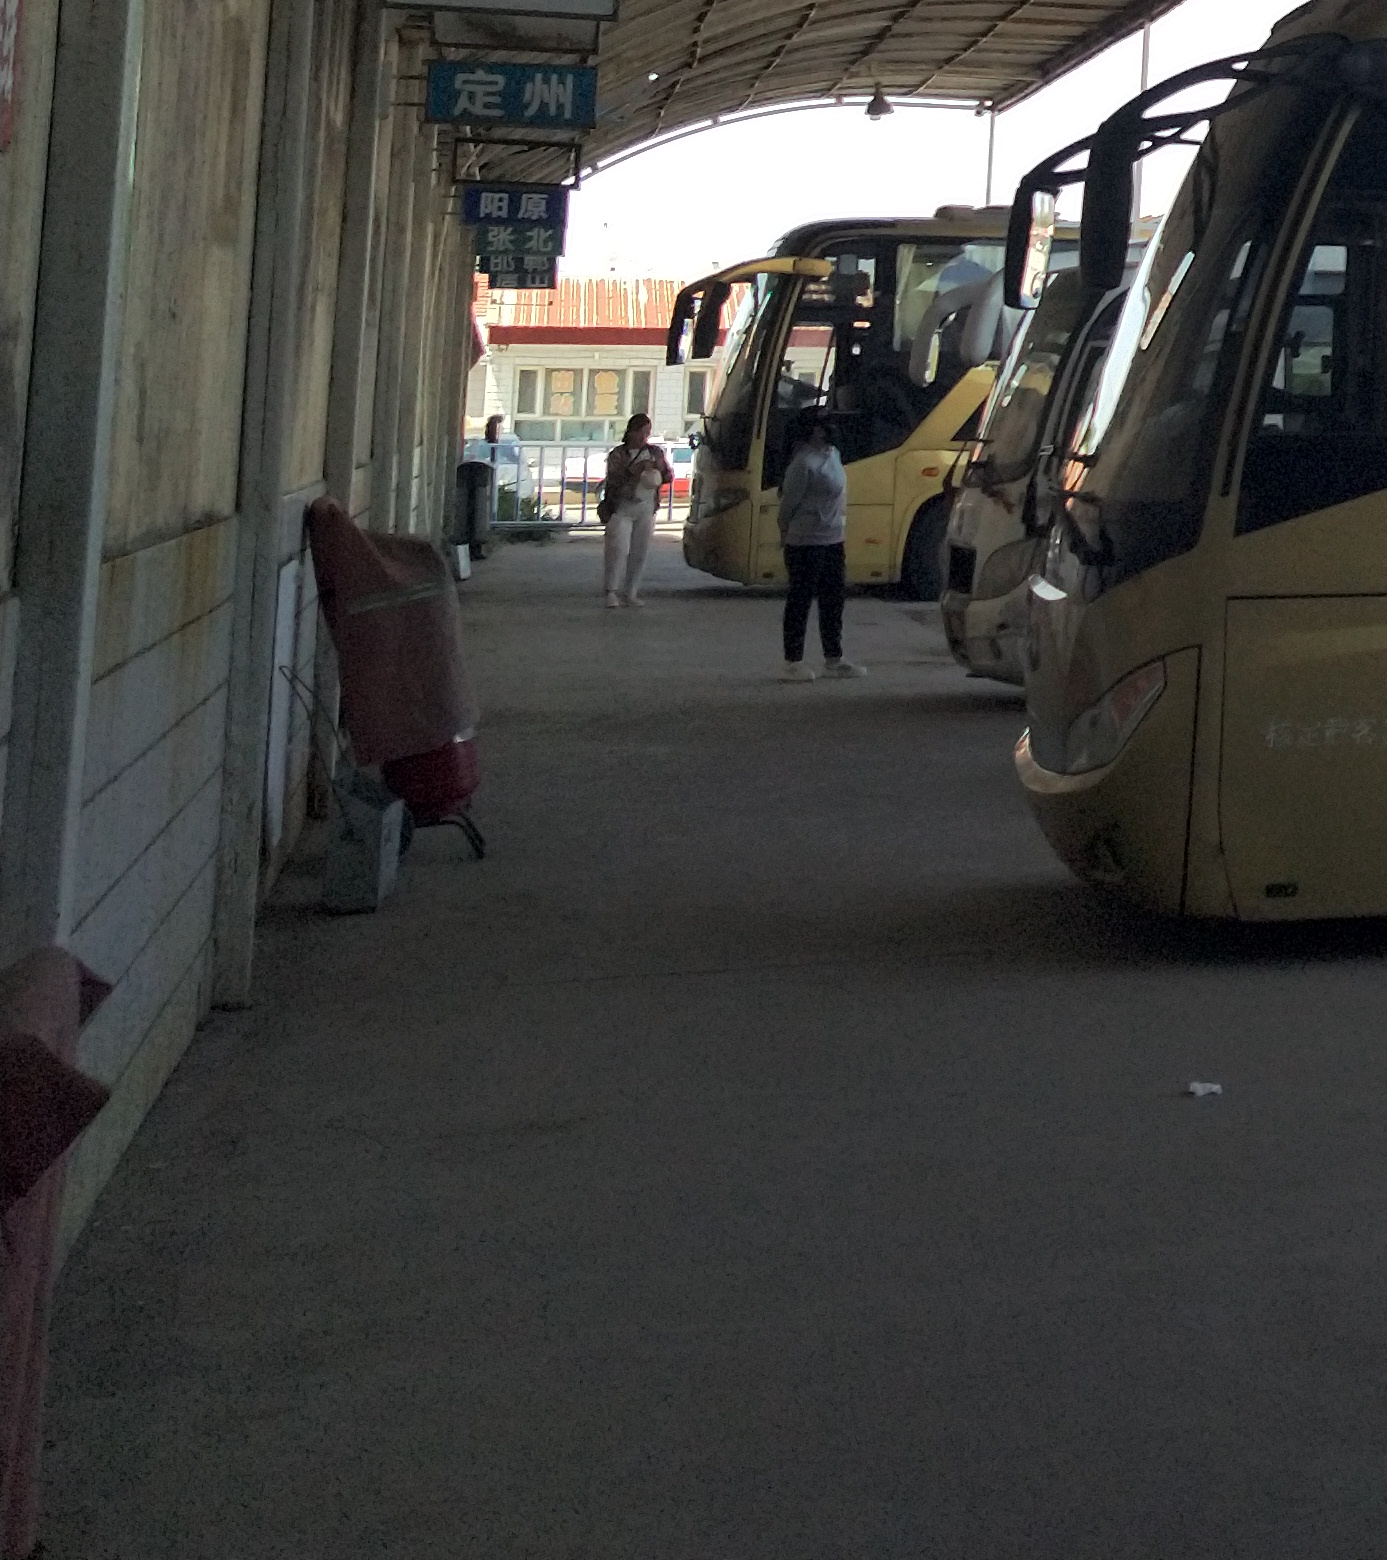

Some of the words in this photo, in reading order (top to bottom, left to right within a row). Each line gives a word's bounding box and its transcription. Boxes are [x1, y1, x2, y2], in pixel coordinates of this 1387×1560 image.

[452, 69, 575, 120] 定州
[478, 192, 551, 221] 阳原
[486, 226, 554, 252] 张北
